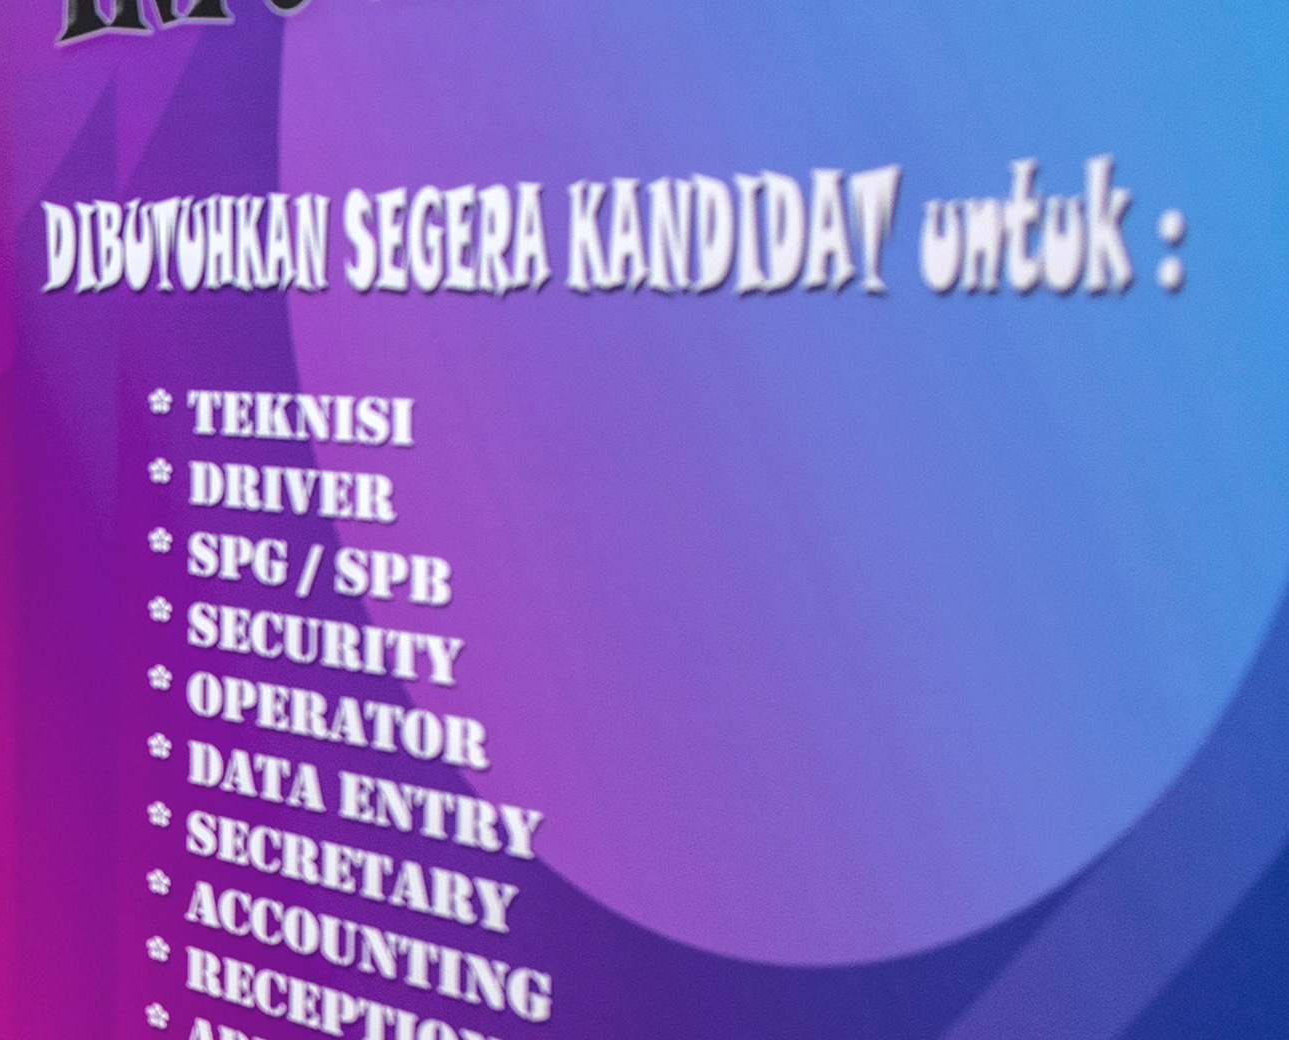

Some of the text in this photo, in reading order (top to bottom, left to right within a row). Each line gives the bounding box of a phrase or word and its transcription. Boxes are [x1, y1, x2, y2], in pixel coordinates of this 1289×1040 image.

[41, 193, 332, 295] DIBUTUHKAN
[343, 181, 552, 297] SEGERA
[566, 164, 903, 297] KANDIDAT
[919, 154, 1133, 295] untuk
[187, 389, 416, 447] TEKNISI
[188, 460, 398, 523] DRIVER
[187, 531, 289, 586] SPG
[334, 547, 453, 607] SPB
[187, 601, 465, 686] SECURITY
[186, 671, 490, 770] OPERATOR
[188, 740, 544, 859] DATA ENTRY
[185, 811, 520, 933] SECRETARY
[184, 880, 554, 1023] ACCOUNTING
